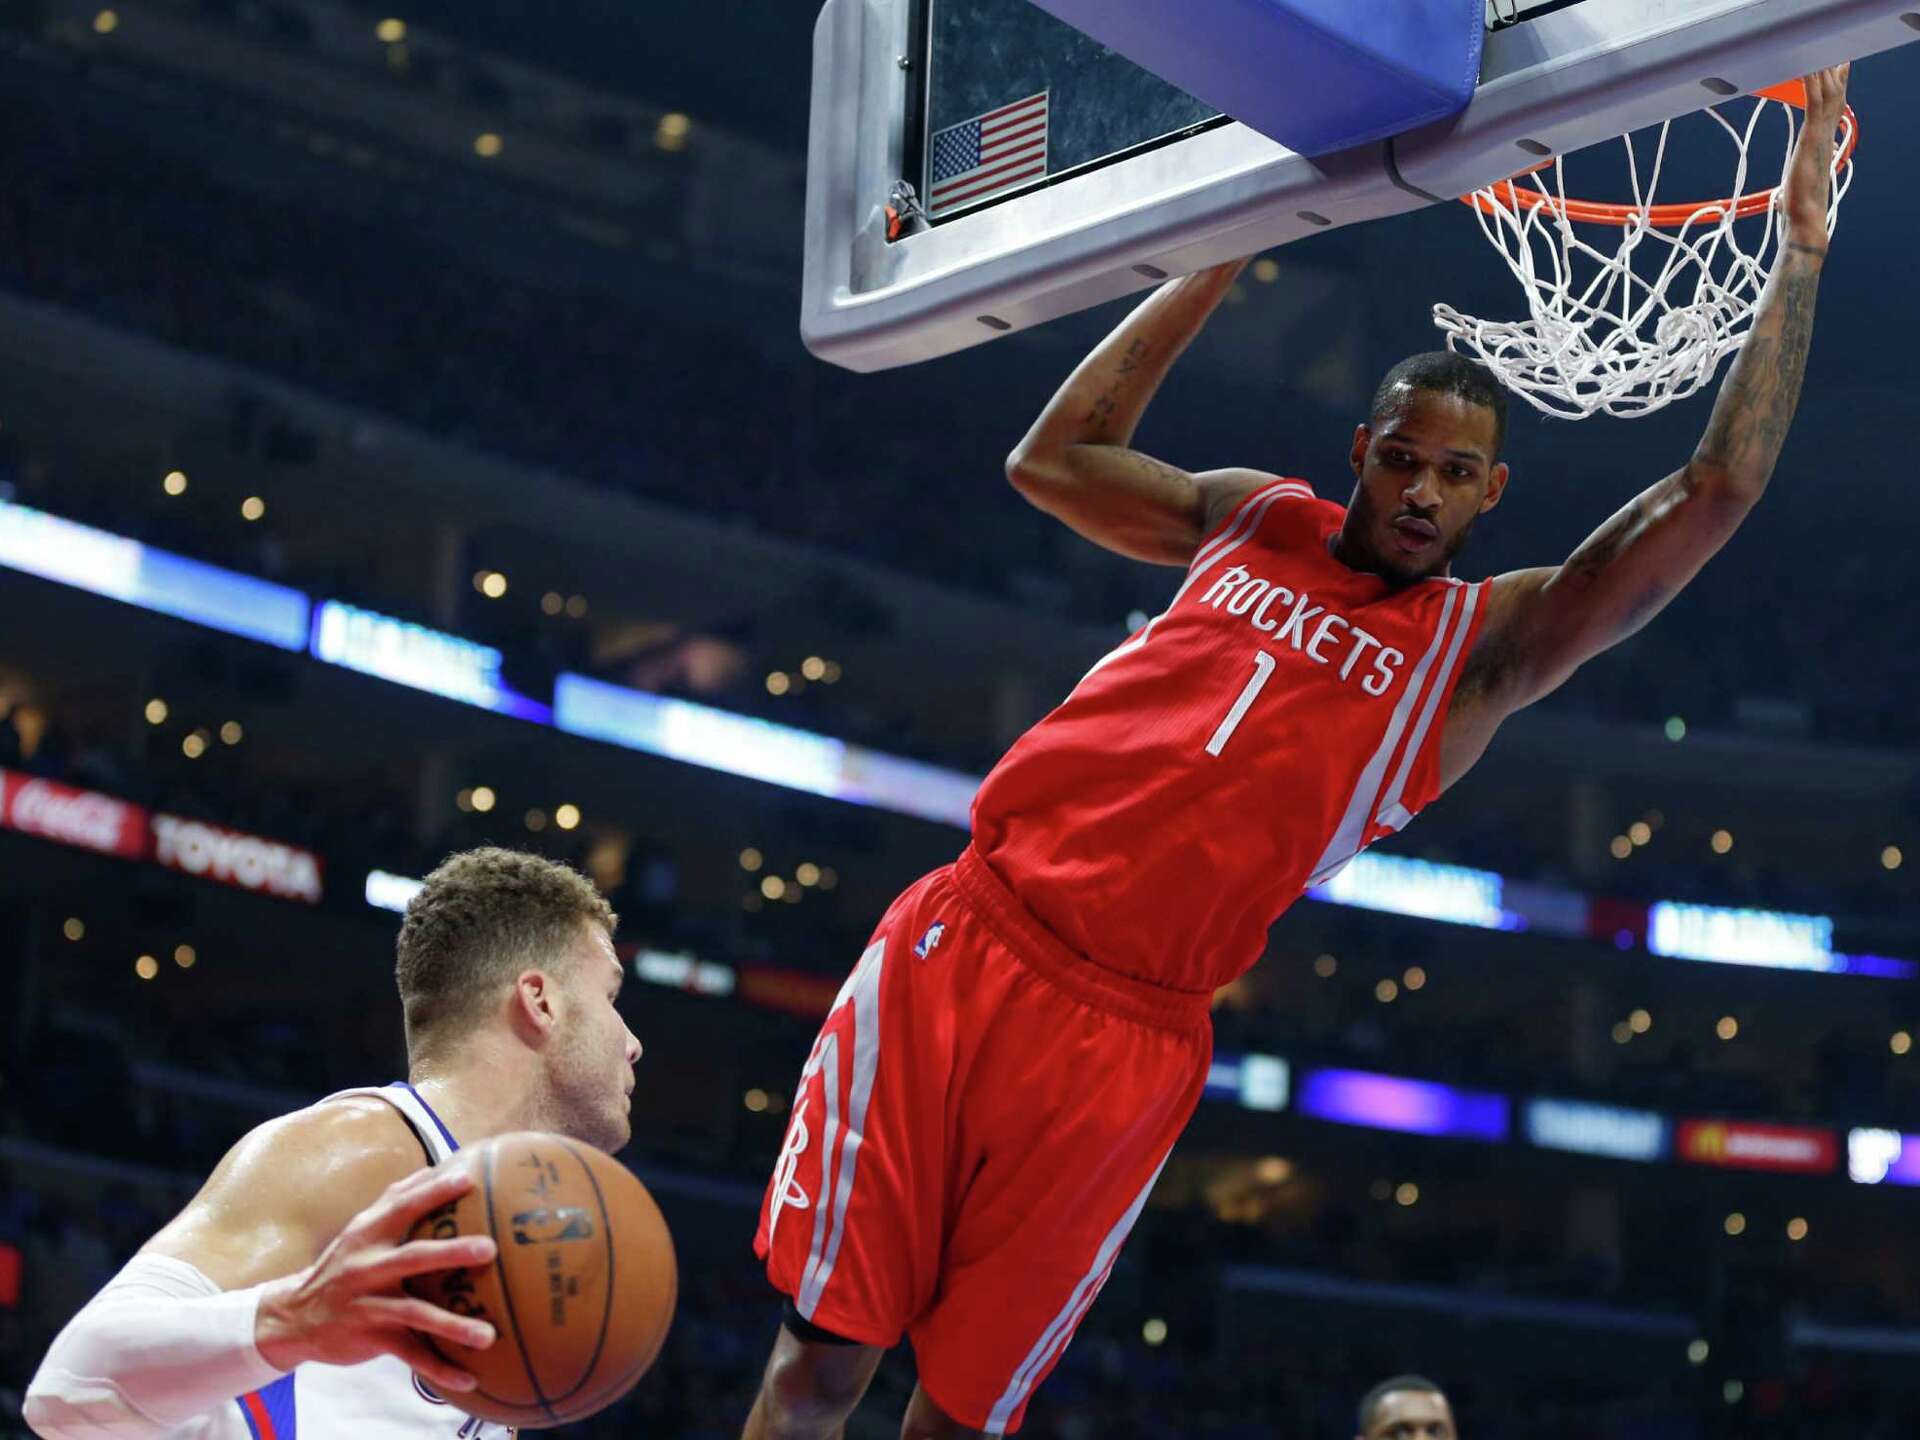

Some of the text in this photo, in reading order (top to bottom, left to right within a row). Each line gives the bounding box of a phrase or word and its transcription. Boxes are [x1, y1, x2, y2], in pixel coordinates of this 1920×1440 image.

[1199, 564, 1404, 696] ROCKETS
[1205, 650, 1276, 757] 1
[153, 814, 321, 902] TOYOTA
